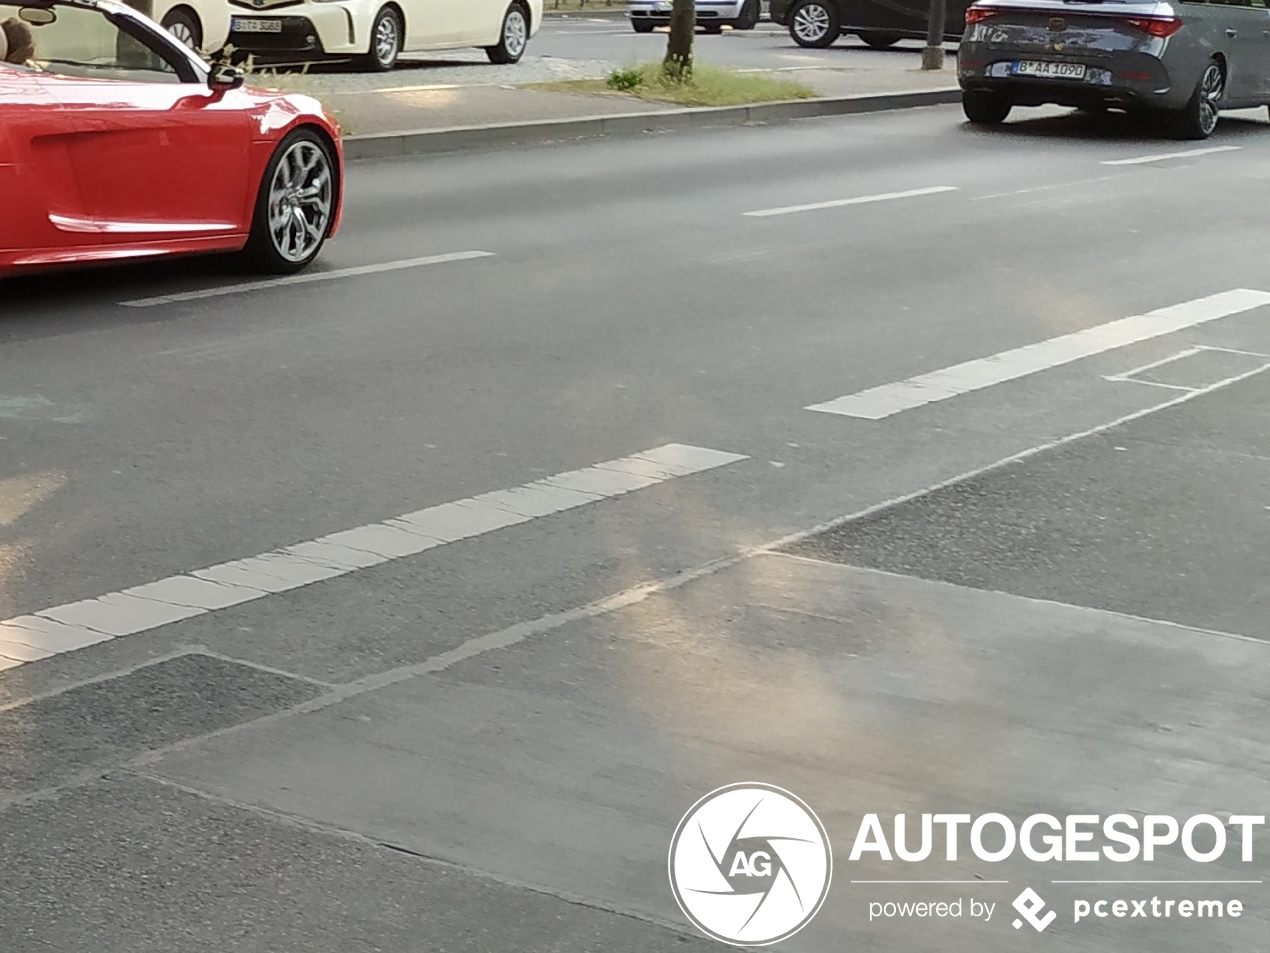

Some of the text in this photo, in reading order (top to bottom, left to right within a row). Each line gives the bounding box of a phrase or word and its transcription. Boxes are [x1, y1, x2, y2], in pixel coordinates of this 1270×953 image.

[1019, 61, 1083, 76] B AA 1090
